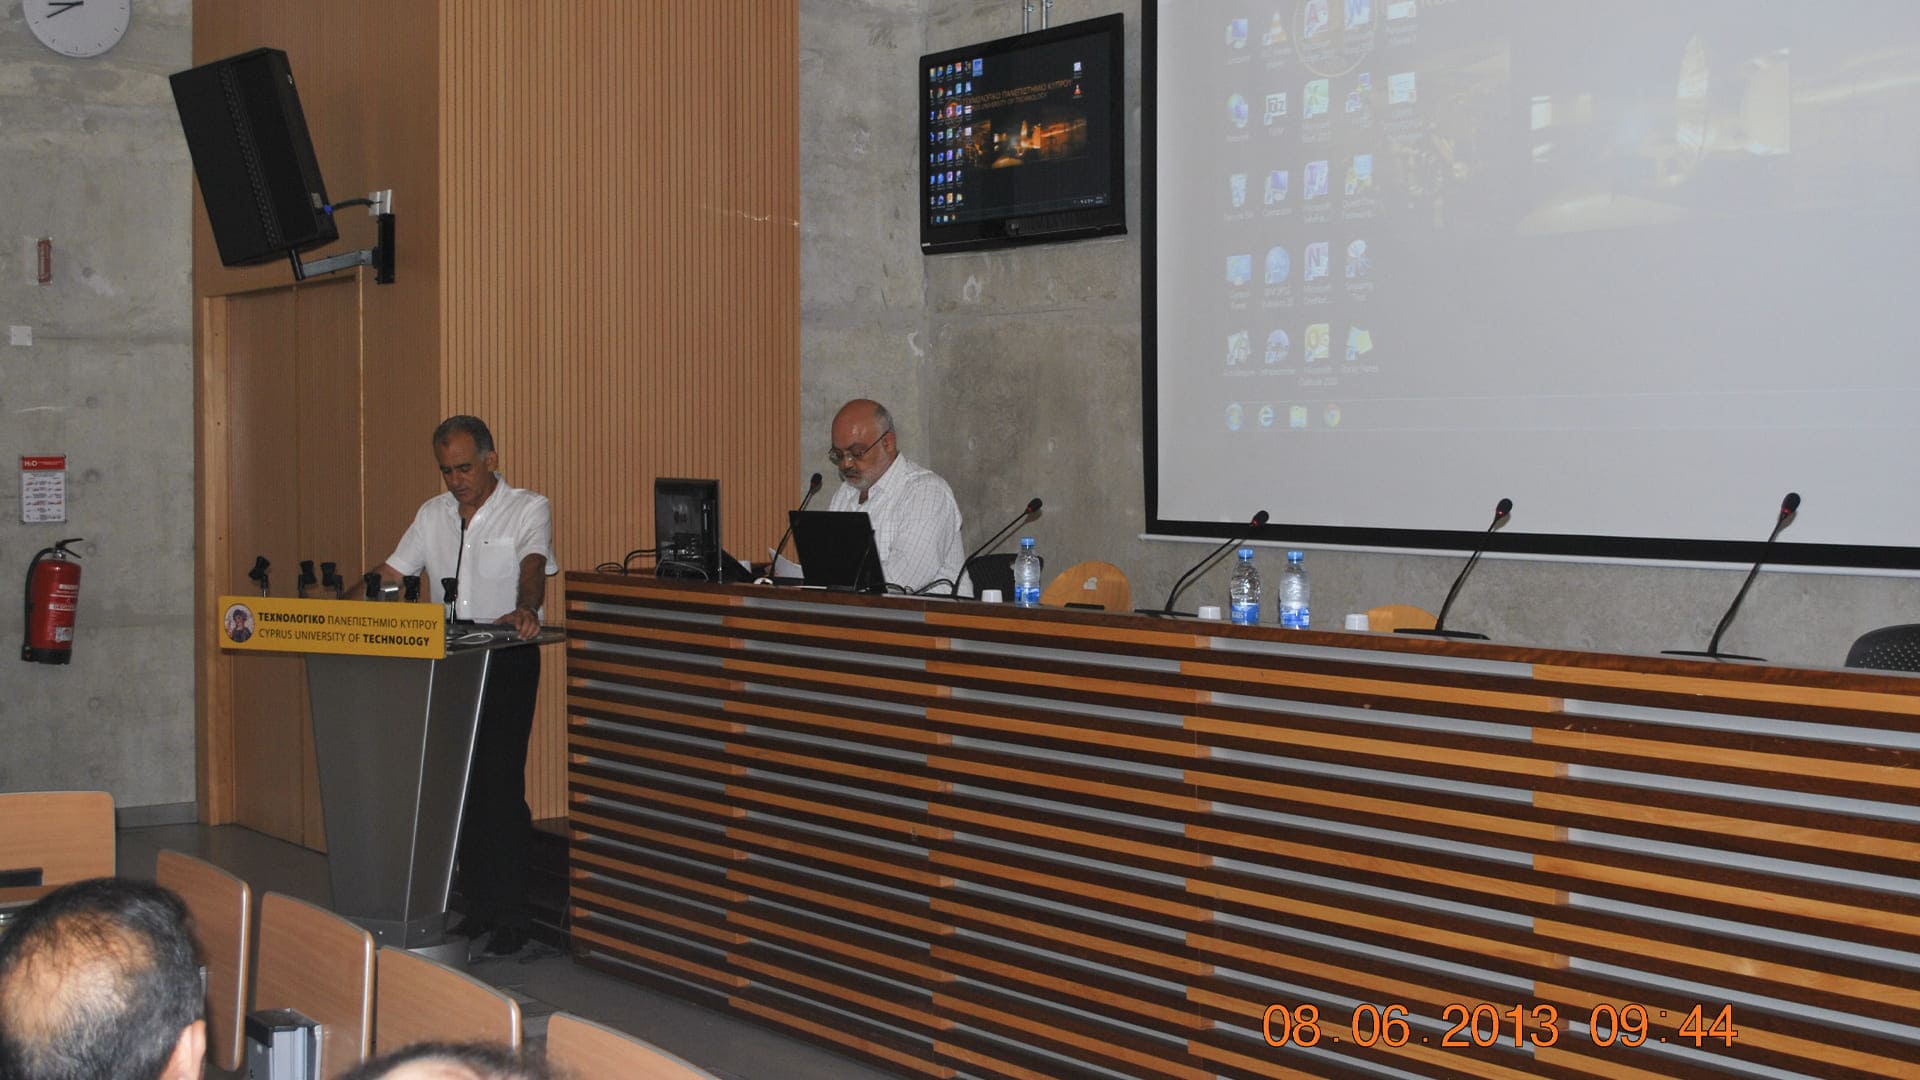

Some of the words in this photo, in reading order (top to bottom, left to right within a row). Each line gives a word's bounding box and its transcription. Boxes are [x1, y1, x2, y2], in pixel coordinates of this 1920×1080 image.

[258, 612, 326, 625] ΤΕΧΝΟΛΟΓΙΚΟ
[328, 615, 398, 628] ΠΑΝΕΠΙΣΤΗΜΙΟ
[400, 617, 438, 630] ΚΥΠΡΟΥ
[259, 628, 293, 640] CYPRUS
[295, 630, 346, 642] UNIVERSITY
[348, 632, 362, 643] OF
[363, 634, 430, 647] TECHNOLOGY
